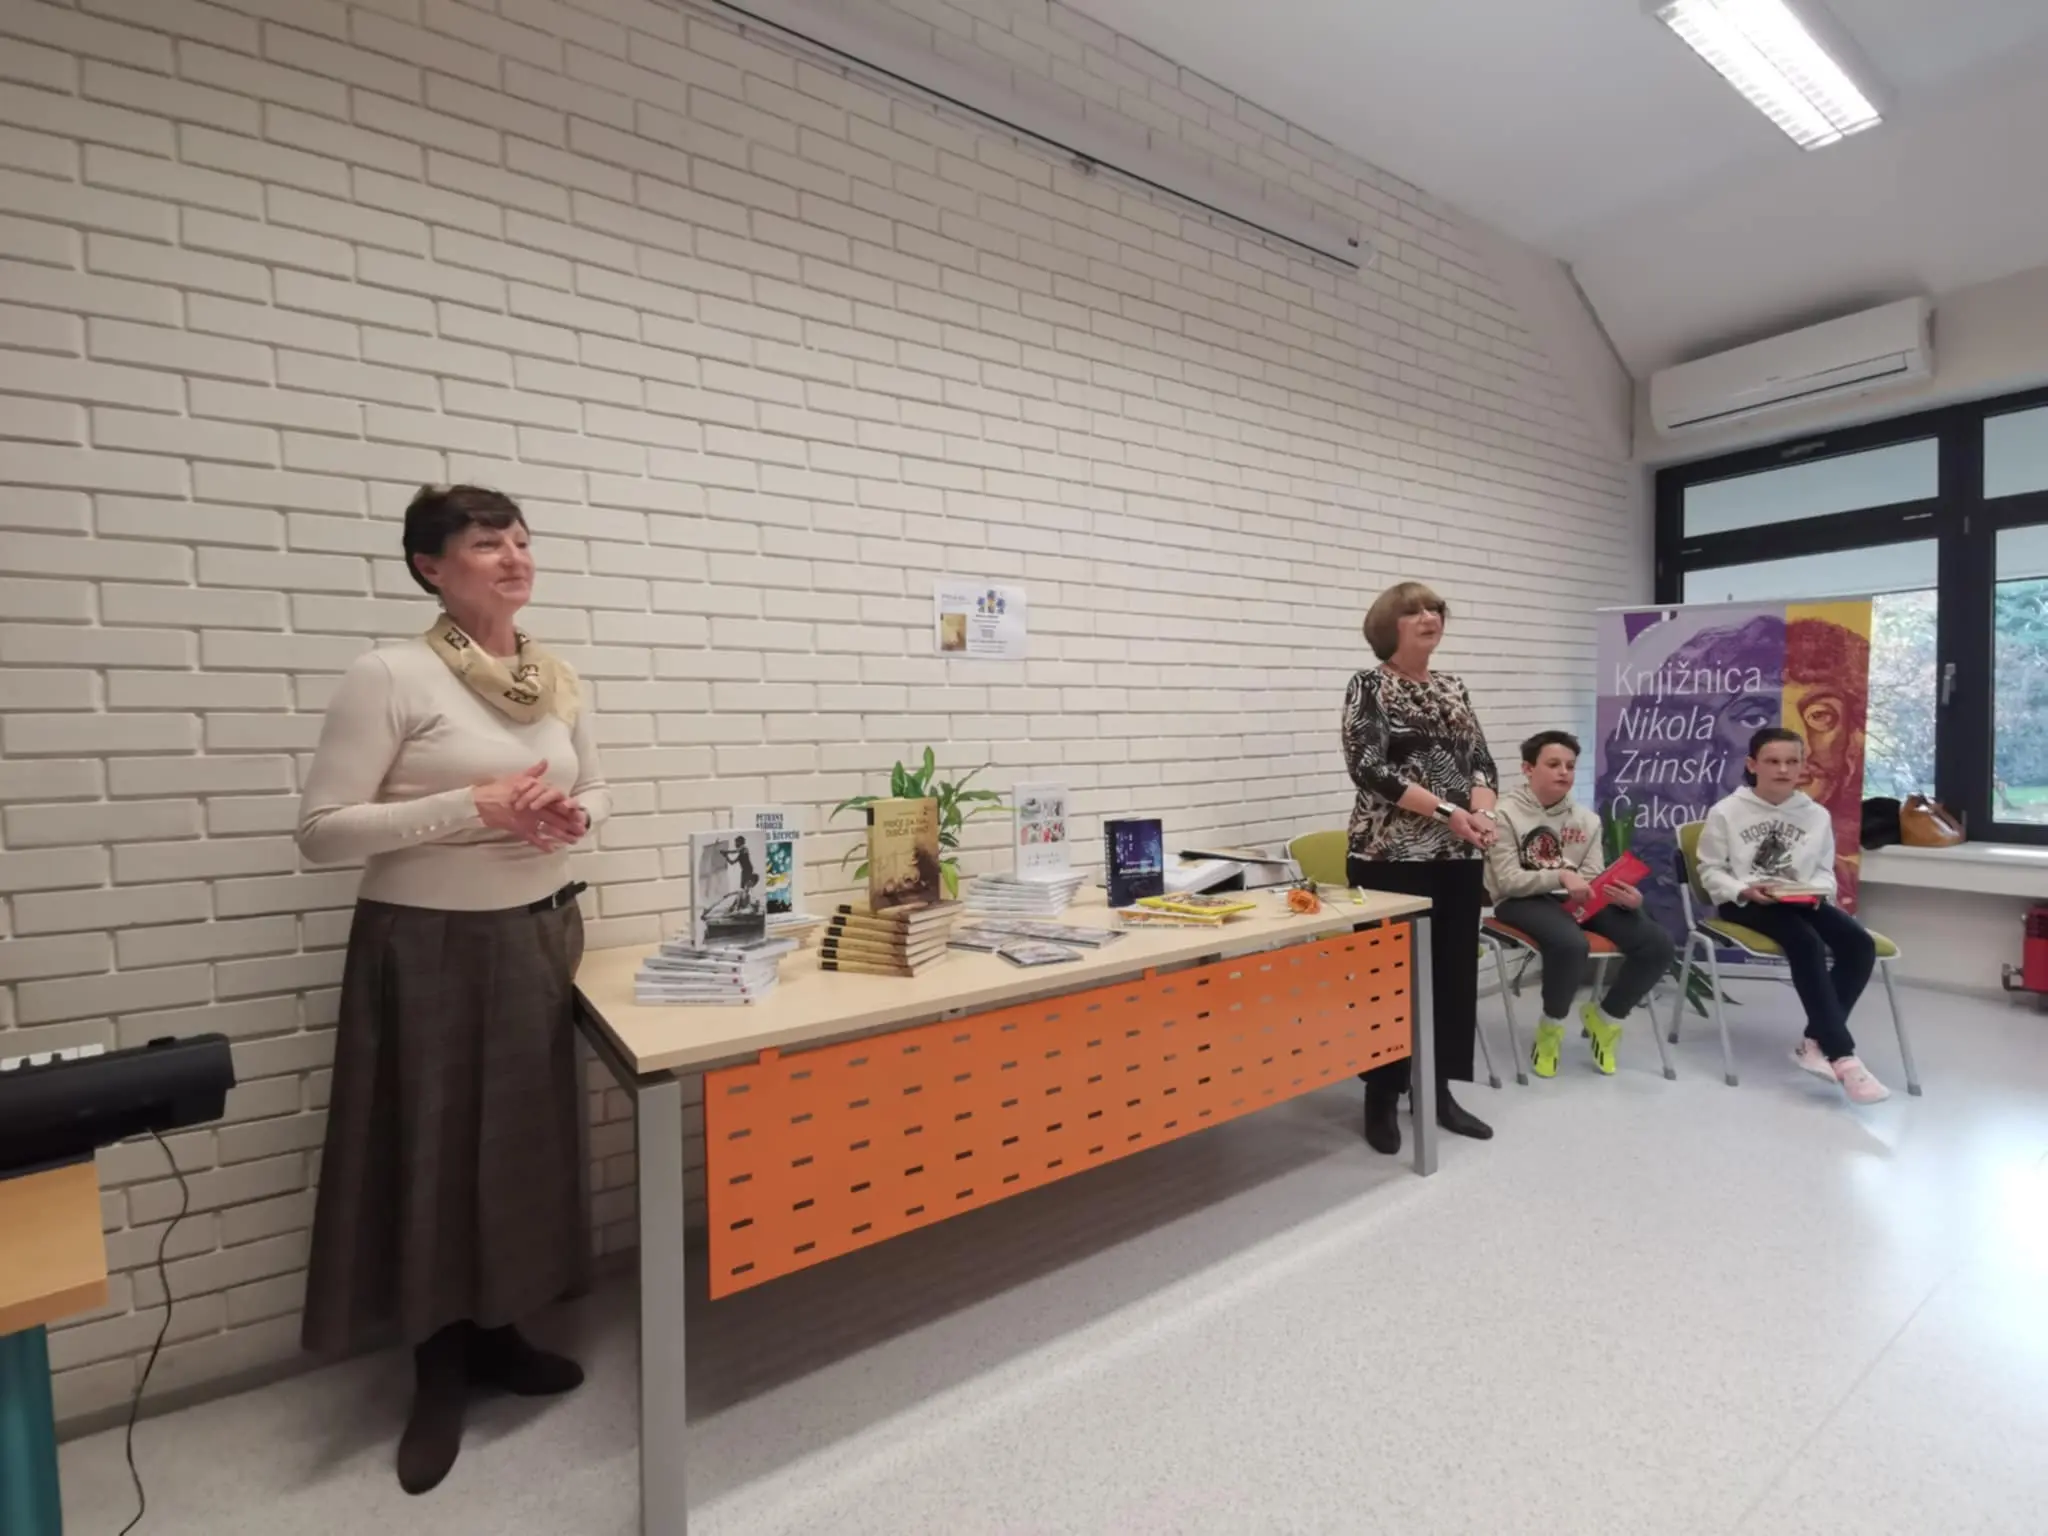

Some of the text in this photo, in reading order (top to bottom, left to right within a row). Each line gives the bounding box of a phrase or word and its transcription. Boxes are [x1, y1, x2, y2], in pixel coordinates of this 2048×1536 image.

[1615, 661, 1761, 703] Knjižnica
[1614, 706, 1715, 741] Nikola
[1613, 750, 1728, 785] Zrinski
[1611, 786, 1707, 828] Čakov
[1739, 819, 1807, 846] HOGWART
